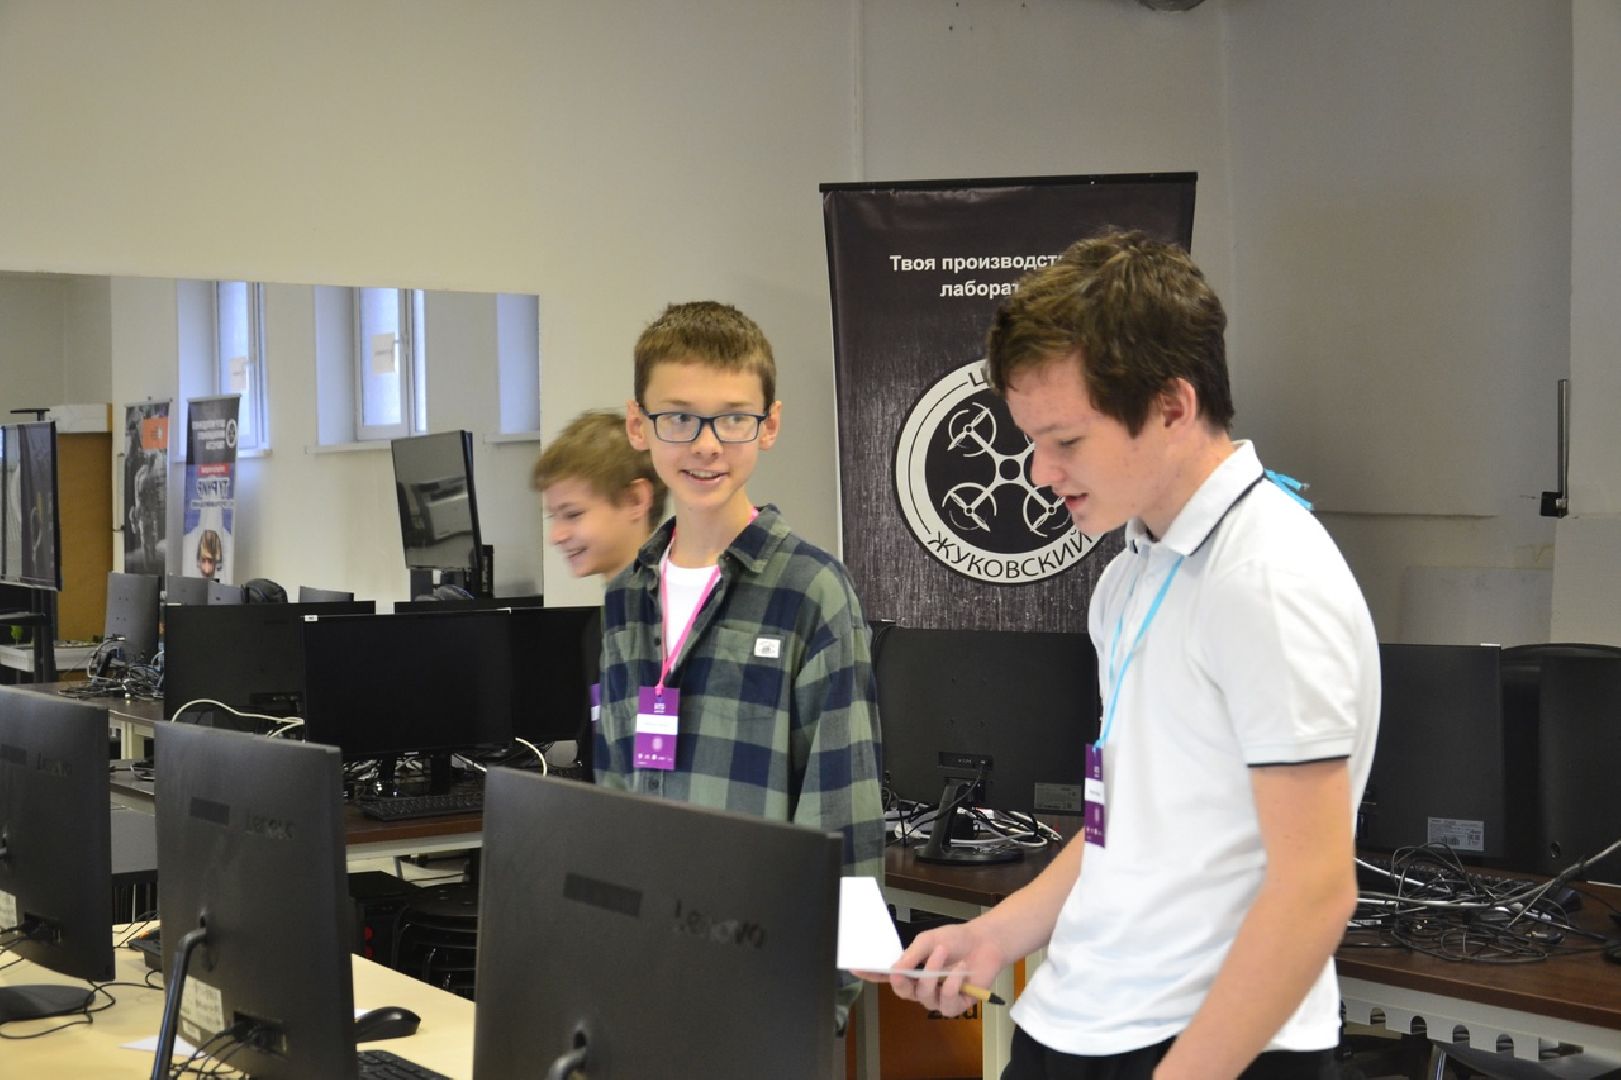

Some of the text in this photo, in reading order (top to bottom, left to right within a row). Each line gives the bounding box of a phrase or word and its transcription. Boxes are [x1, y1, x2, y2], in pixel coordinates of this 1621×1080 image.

[889, 254, 1064, 274] Твоя производст
[939, 279, 1020, 300] лаборат
[927, 529, 1093, 579] ЖУКОВСКИЙ
